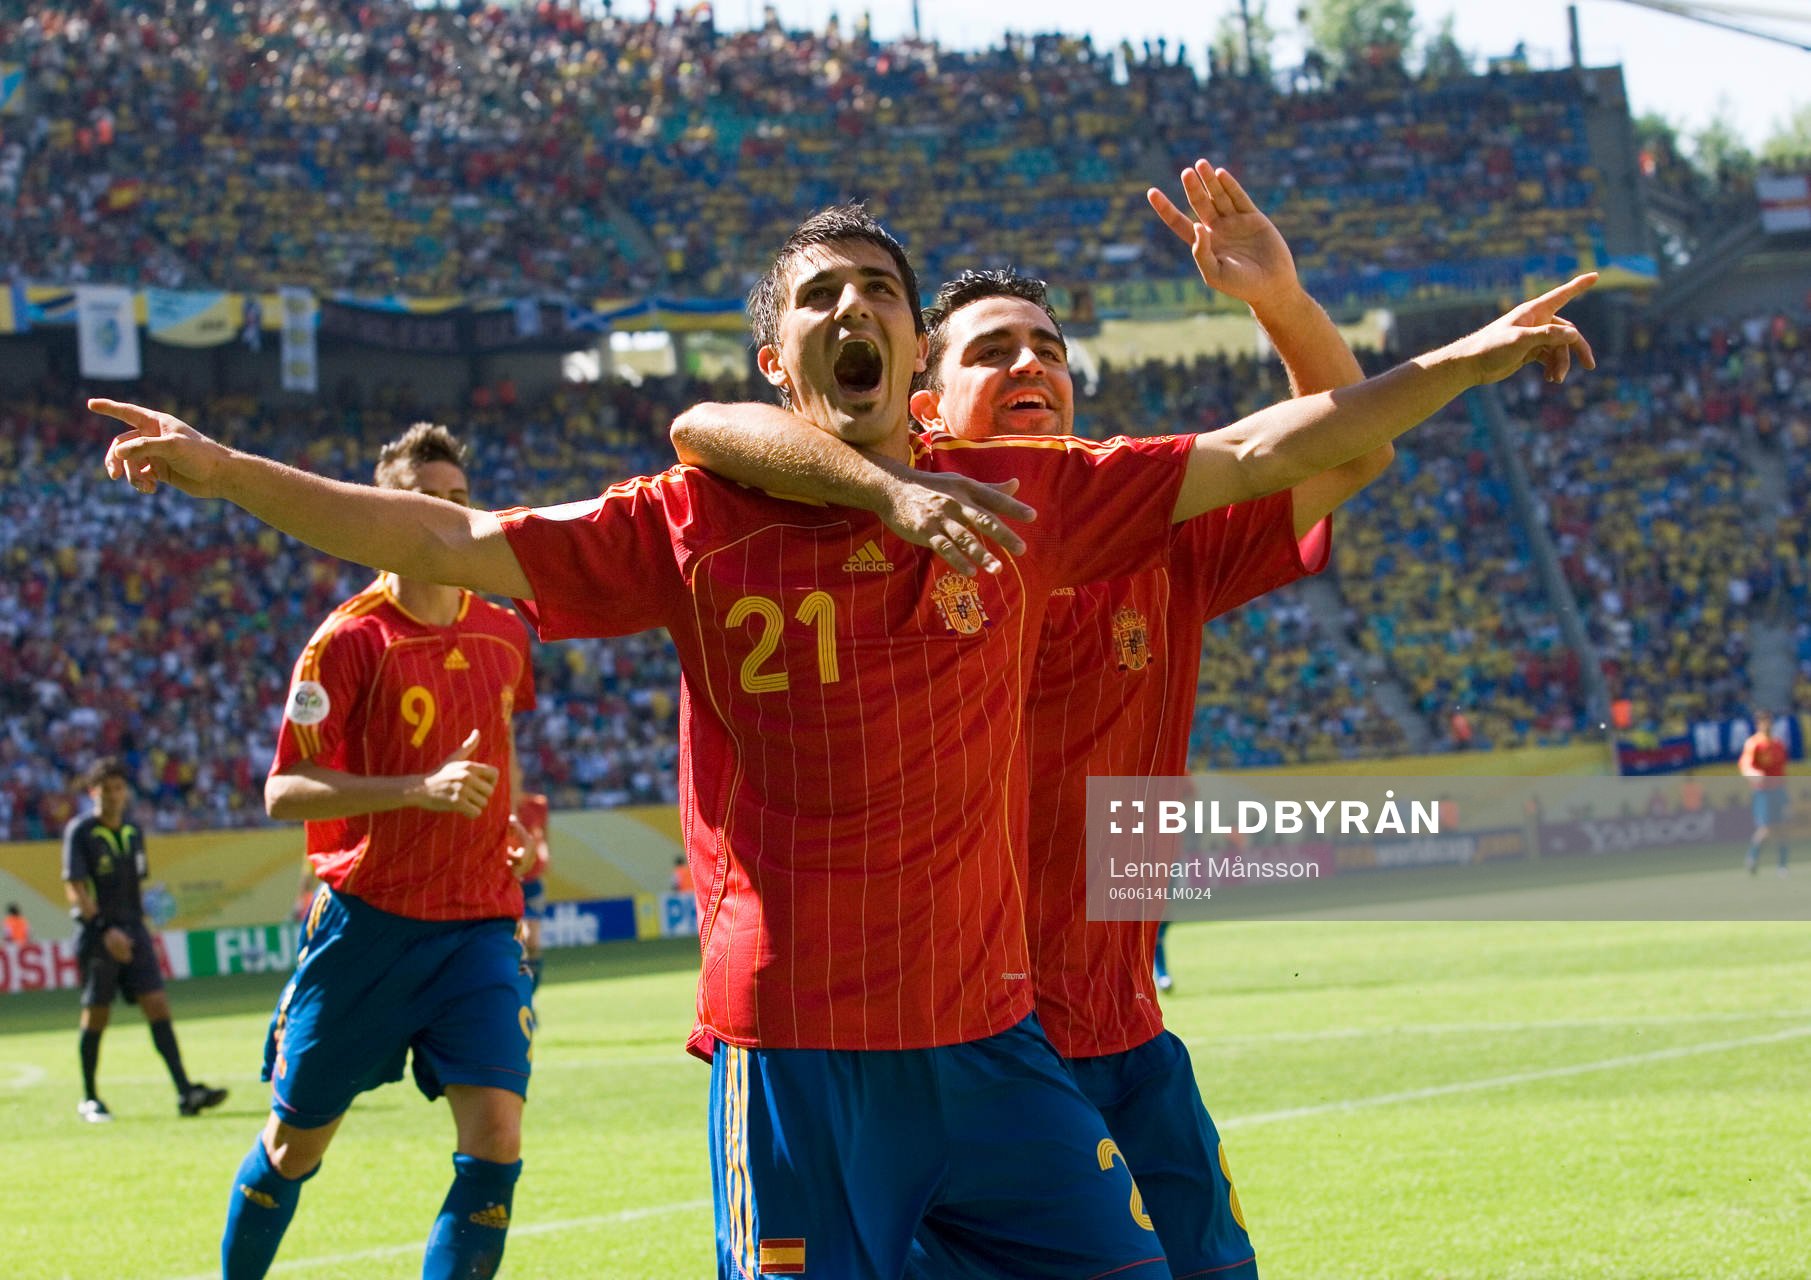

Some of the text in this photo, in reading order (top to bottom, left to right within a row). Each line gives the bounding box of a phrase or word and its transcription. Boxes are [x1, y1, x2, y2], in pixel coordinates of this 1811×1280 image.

[842, 560, 895, 573] adidas
[725, 590, 840, 694] 21
[400, 685, 436, 748] 9
